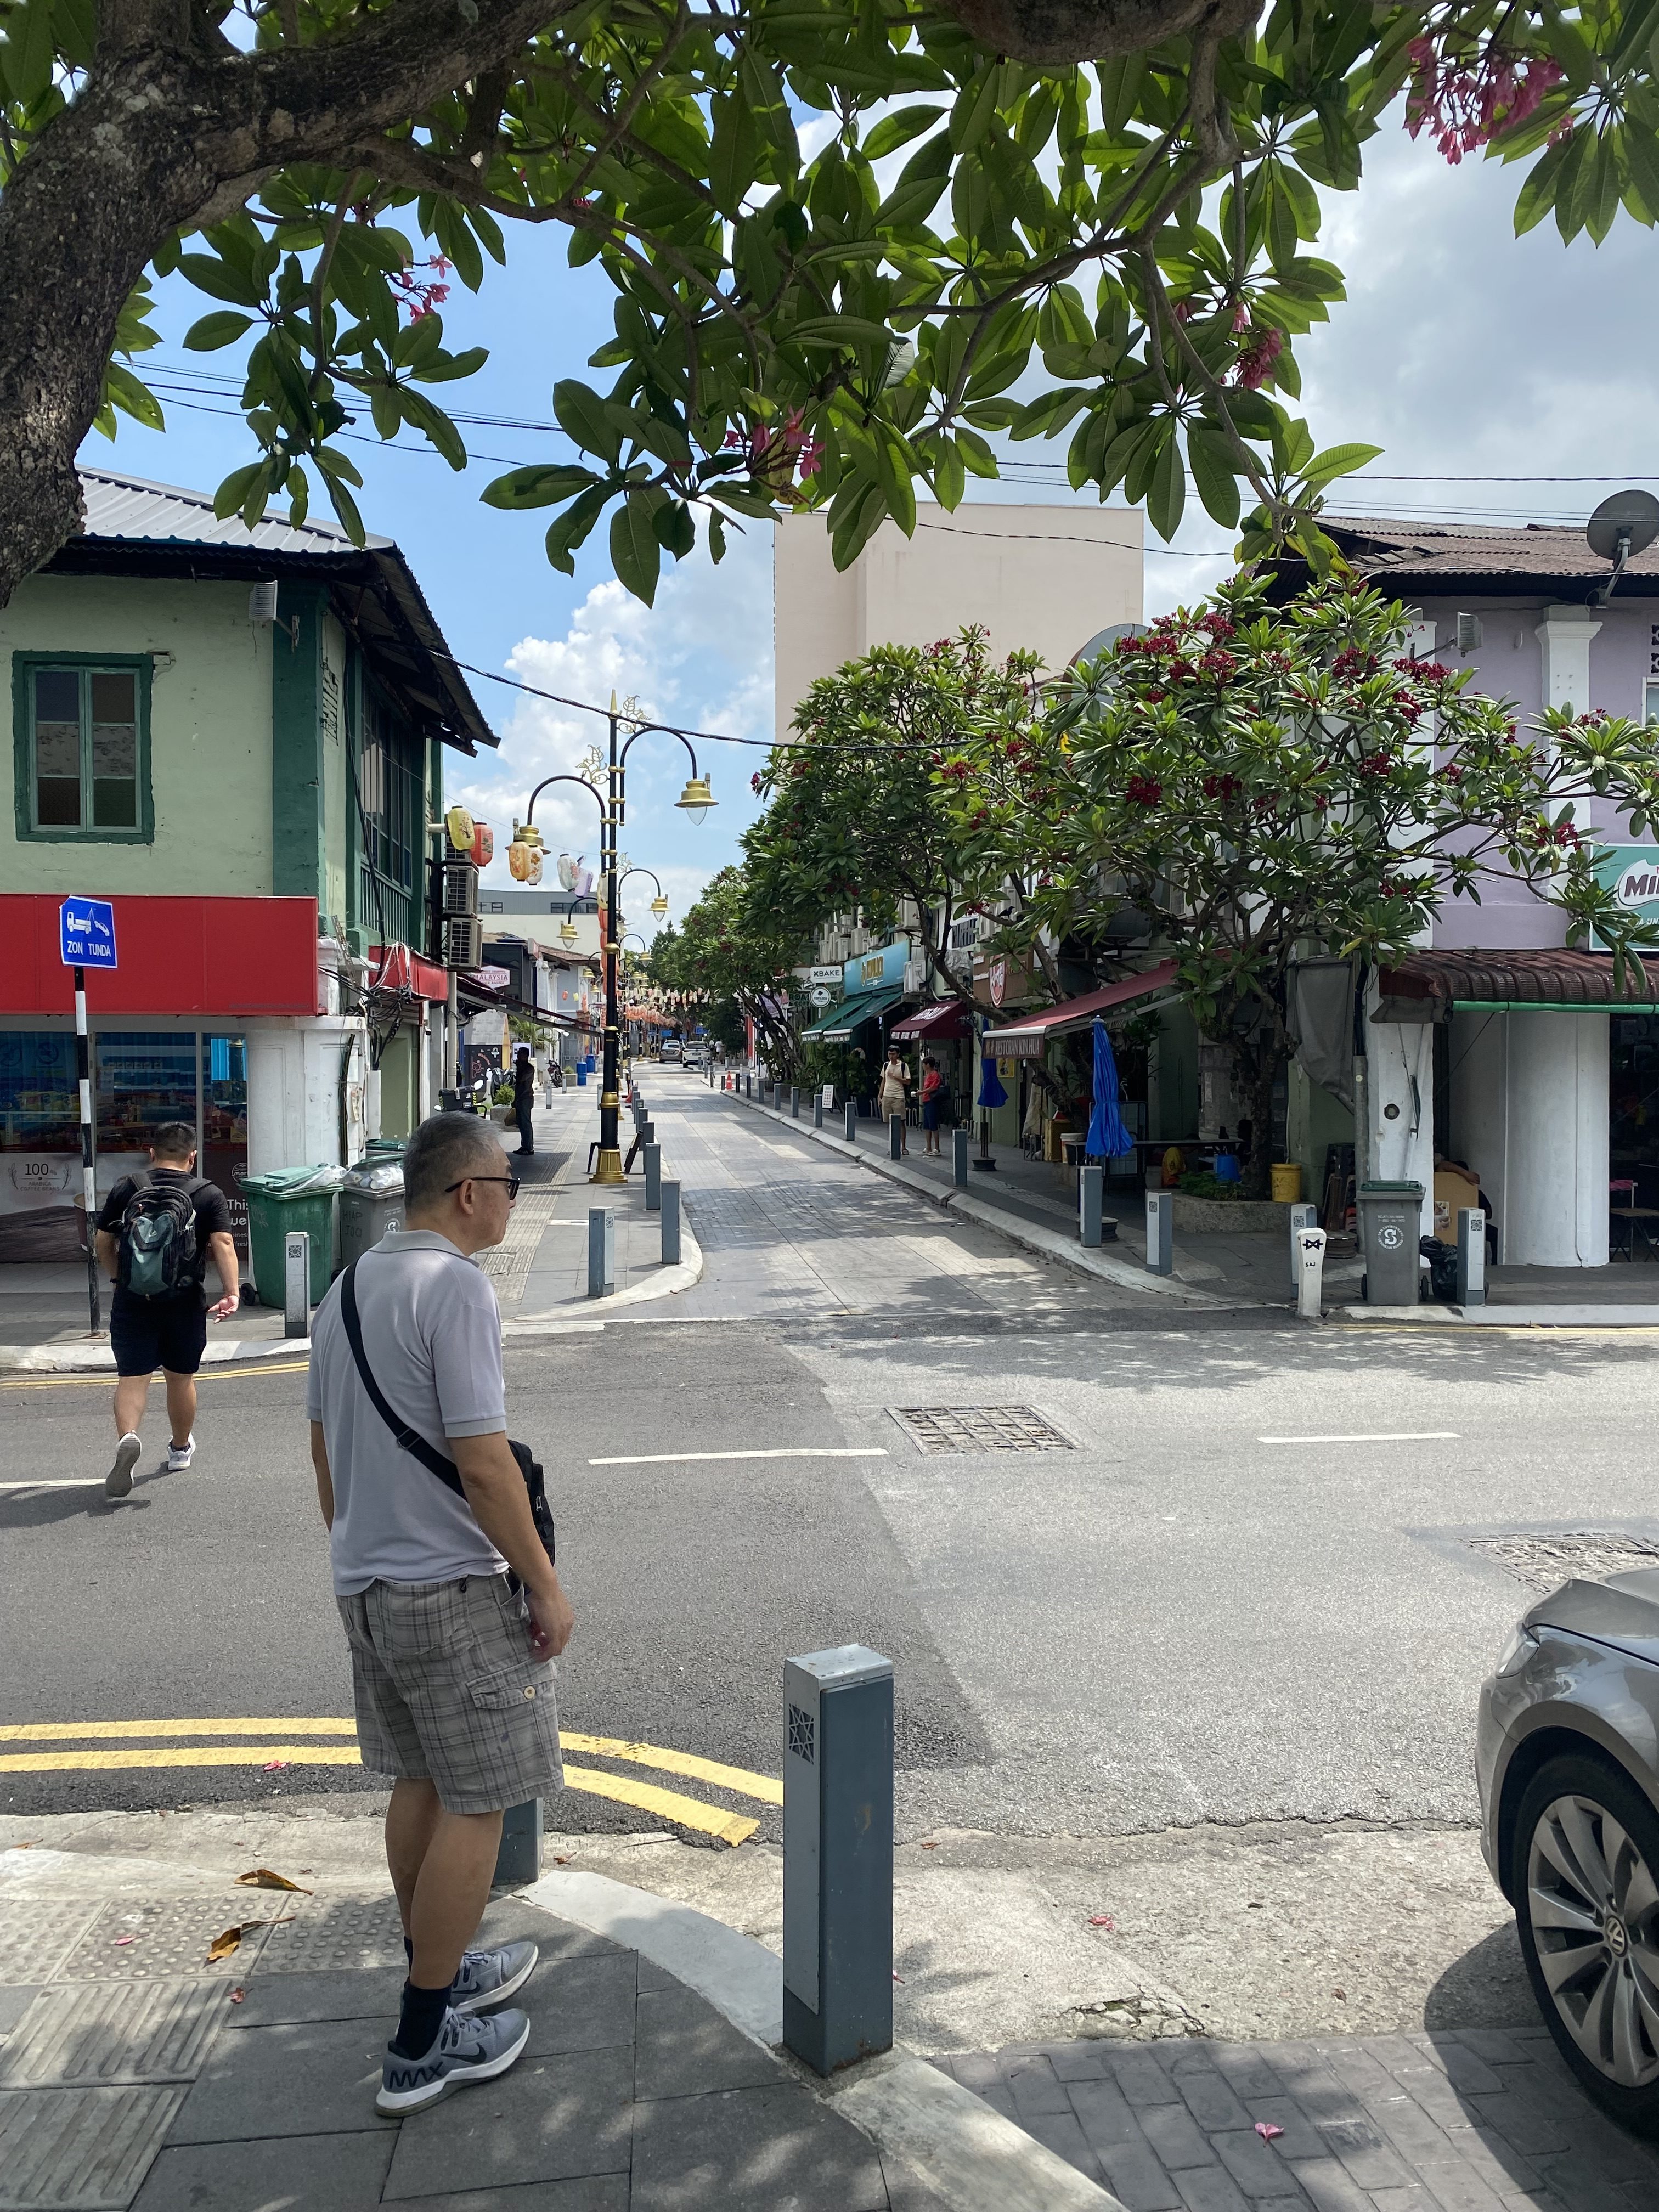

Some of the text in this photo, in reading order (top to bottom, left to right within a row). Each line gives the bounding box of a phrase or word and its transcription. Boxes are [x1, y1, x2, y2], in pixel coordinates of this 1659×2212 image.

[1624, 874, 1659, 898] MI
[67, 940, 111, 957] ZON TUNDA
[1019, 1039, 1029, 1054] KIN
[1028, 1038, 1040, 1054] HUA
[389, 2062, 444, 2090] MAX
